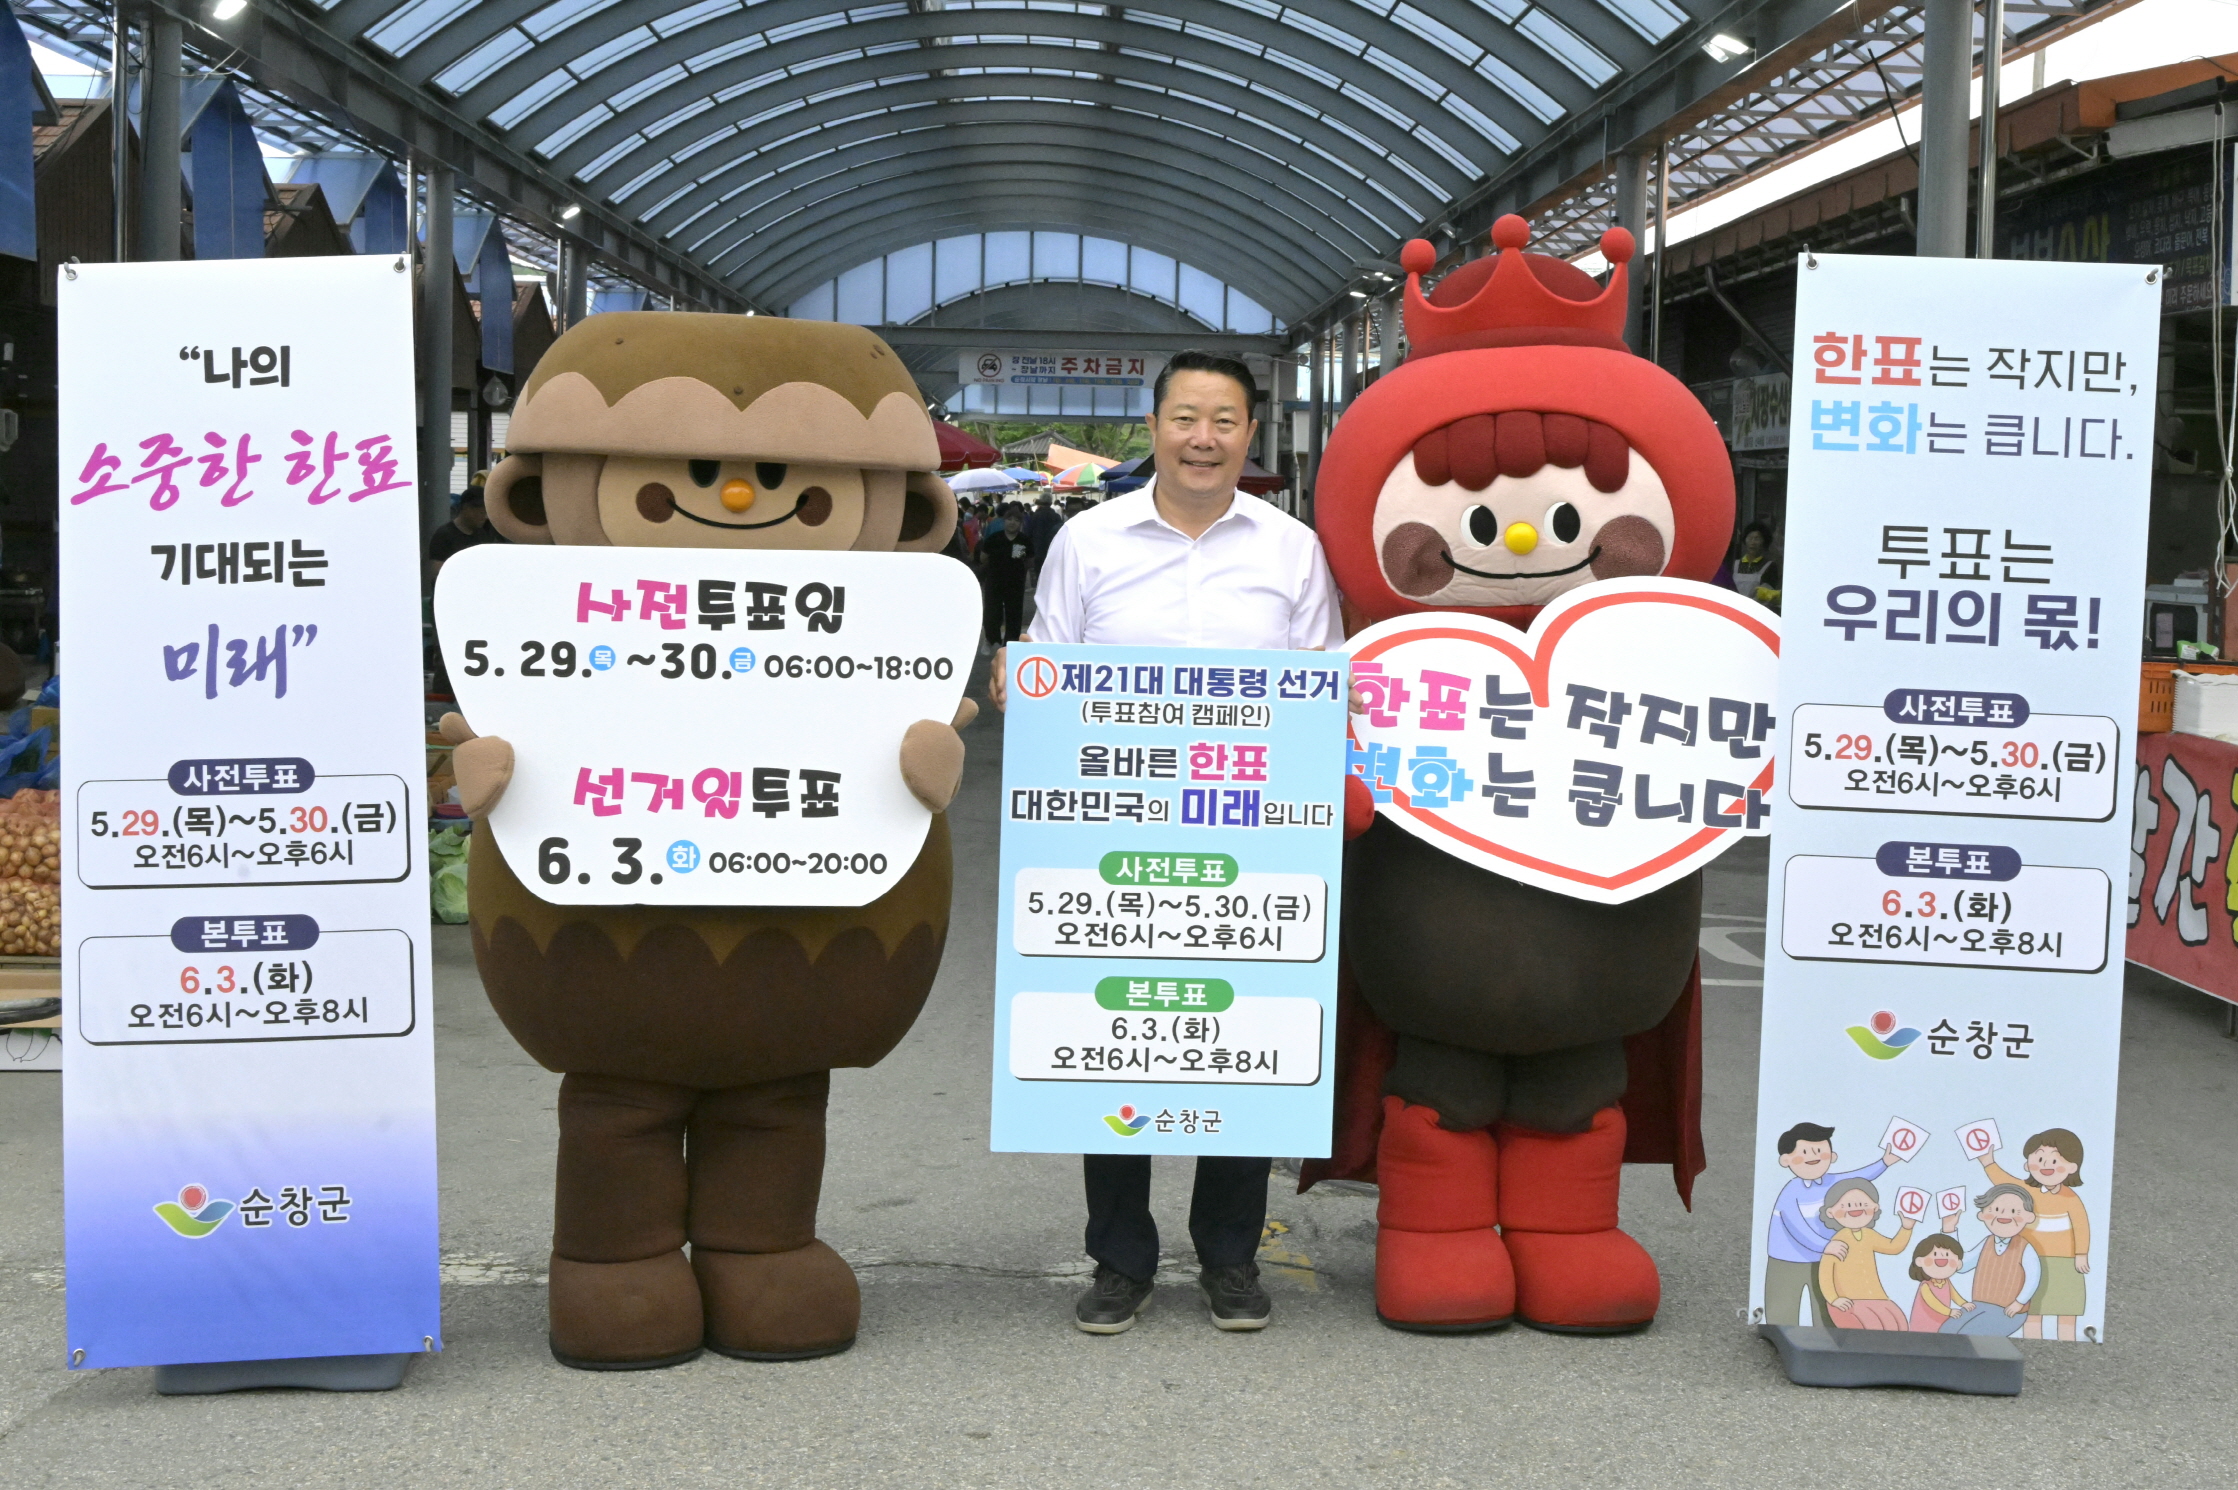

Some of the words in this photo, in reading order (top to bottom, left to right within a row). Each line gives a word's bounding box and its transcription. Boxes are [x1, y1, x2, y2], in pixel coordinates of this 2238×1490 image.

[1021, 366, 1056, 374] 장날까지
[1039, 357, 1056, 365] 18시
[1061, 358, 1144, 375] 주차금지
[1814, 332, 1970, 387] 한표는
[1987, 348, 2136, 396] 작지만,
[1811, 400, 1967, 454] 변화는
[1985, 415, 2133, 460] 큽니다.
[71, 432, 262, 511] 소중한
[284, 430, 412, 505] 한표
[151, 539, 328, 587] 기대되는
[1878, 525, 2053, 584] 투표는
[577, 580, 845, 634] 사전투표일
[1824, 585, 2001, 646] 우리의
[2024, 595, 2100, 651] 몫!
[764, 655, 953, 680] 06:00~18:00
[1062, 663, 1163, 695] 제21대
[1174, 666, 1269, 700] 대통령
[1277, 669, 1339, 700] 선거
[1082, 701, 1183, 725] (투표참여
[1193, 704, 1270, 727] 캠페인)
[1351, 662, 1534, 740] 한표는
[1566, 683, 1777, 760] 작지만
[1900, 694, 2015, 724] 사전투표
[1079, 746, 1179, 780] 올바른
[1189, 743, 1268, 782] 한표
[1804, 732, 2107, 774] 5.29.(목)~5.30.(금)
[184, 763, 300, 792] 사전투표
[574, 767, 841, 819] 선거일투표
[1345, 739, 1537, 819] 변화는
[1568, 758, 1771, 830] 큽니다
[1844, 768, 2062, 803] 오전6시~오후6시
[92, 801, 396, 838] 5.29.(목)~5.30.(금)
[1012, 789, 1169, 823] 대한민국의
[1182, 788, 1333, 829] 미래입니다
[134, 837, 352, 869] 오전6시~오후6시
[709, 852, 887, 874] 06:00~20:00
[1116, 856, 1227, 884] 사전투표
[1906, 846, 1991, 875] 본투표
[1028, 890, 1312, 923] 5.29.(목)~5.30.(금)
[1882, 889, 2012, 924] 6.3.(화)
[201, 920, 289, 948] 본투표
[1055, 923, 1283, 951] 오전6시~오후6시
[1828, 922, 2063, 957] 오전6시~오후8시
[181, 961, 312, 995] 6.3.(화)
[1126, 982, 1207, 1006] 본투표
[128, 997, 367, 1028] 오전6시~오후8시
[1111, 1015, 1221, 1044] 6.3.(화)
[1928, 1019, 2034, 1059] 순창군
[1050, 1046, 1278, 1075] 오전6시~오후8시
[1154, 1109, 1222, 1134] 순창군
[239, 1186, 351, 1228] 순창군
